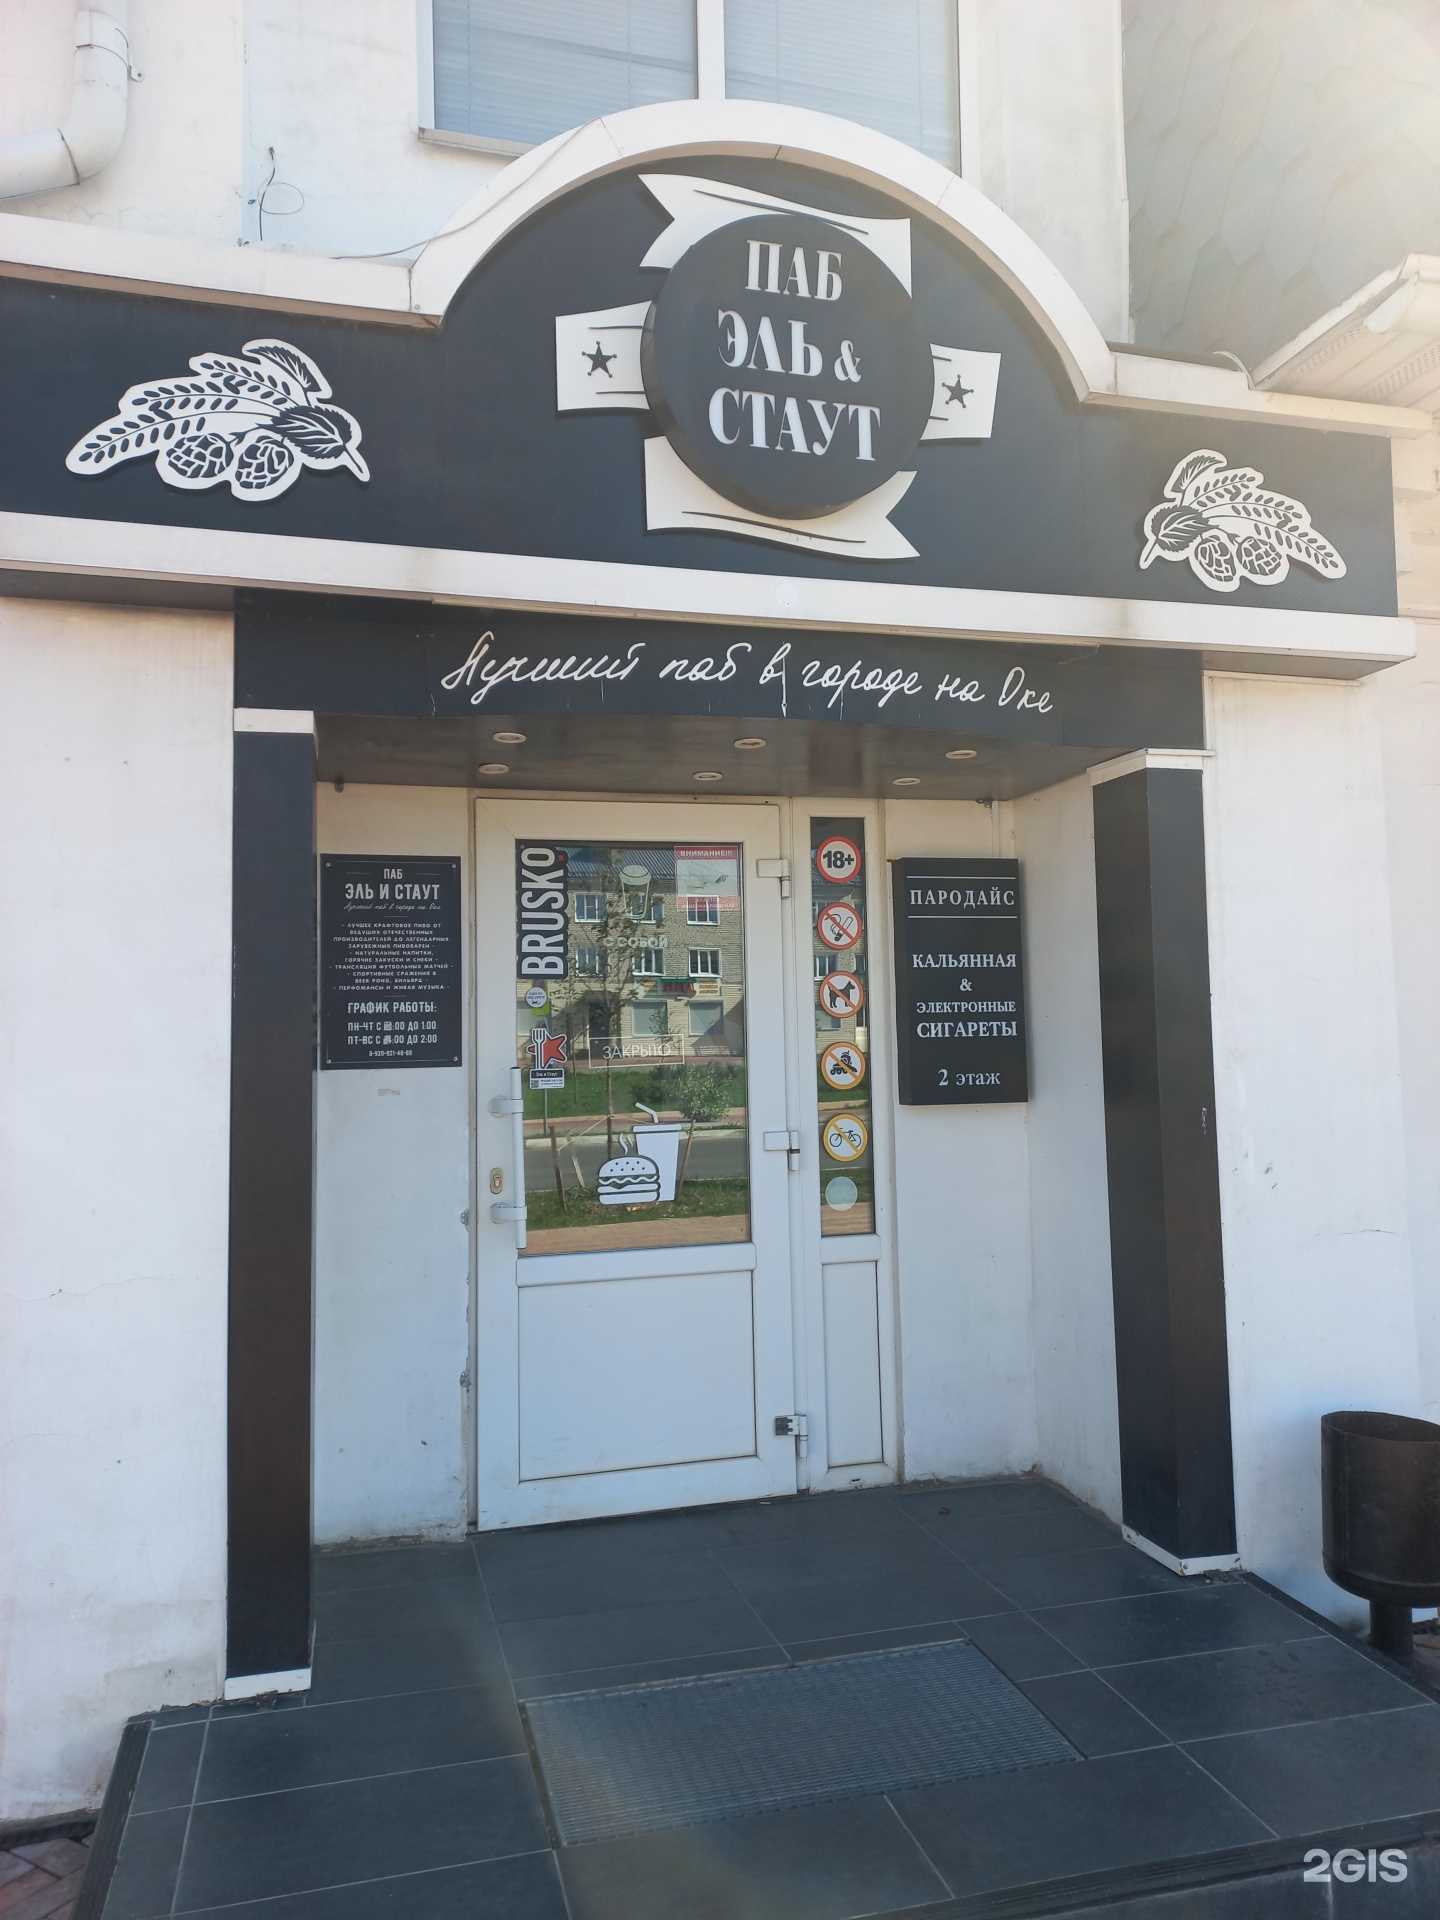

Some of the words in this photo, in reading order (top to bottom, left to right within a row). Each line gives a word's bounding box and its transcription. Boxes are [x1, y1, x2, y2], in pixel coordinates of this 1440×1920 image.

[745, 239, 843, 301] ПАБ
[717, 309, 823, 377] ЭЛЬ
[833, 339, 863, 383] &
[707, 386, 881, 462] СТАУТ
[441, 630, 646, 705] Лучший
[658, 642, 751, 684] паб
[759, 642, 792, 685] в
[802, 660, 922, 708] городе
[935, 674, 985, 701] на
[998, 666, 1053, 713] Оке
[823, 850, 855, 869] 18+
[384, 869, 403, 879] ПАБ
[345, 883, 374, 899] ЭЛЬ
[379, 884, 389, 900] И
[395, 884, 440, 900] СТАУТ
[910, 886, 1014, 909] ПАРОДАЙС
[521, 847, 564, 974] BRUSKO
[617, 935, 668, 948] СОБОЙ
[912, 954, 1016, 969] КАЛЬЯННАЯ
[960, 978, 972, 991] &
[348, 1002, 389, 1013] ГРАФИК
[393, 1001, 437, 1013] РАБОТЫ:
[917, 1001, 1016, 1014] ЭЛЕКТРОННЫЕ
[348, 1022, 373, 1031] ПН-ЧТ
[376, 1022, 381, 1030] С
[408, 1021, 418, 1031] ДО
[917, 1021, 1018, 1038] СИГАРЕТЫ
[348, 1036, 373, 1045] ПТ-ВС
[375, 1036, 381, 1044] С
[407, 1035, 418, 1045] ДО
[938, 1069, 948, 1086] 2
[956, 1072, 1000, 1085] этаж
